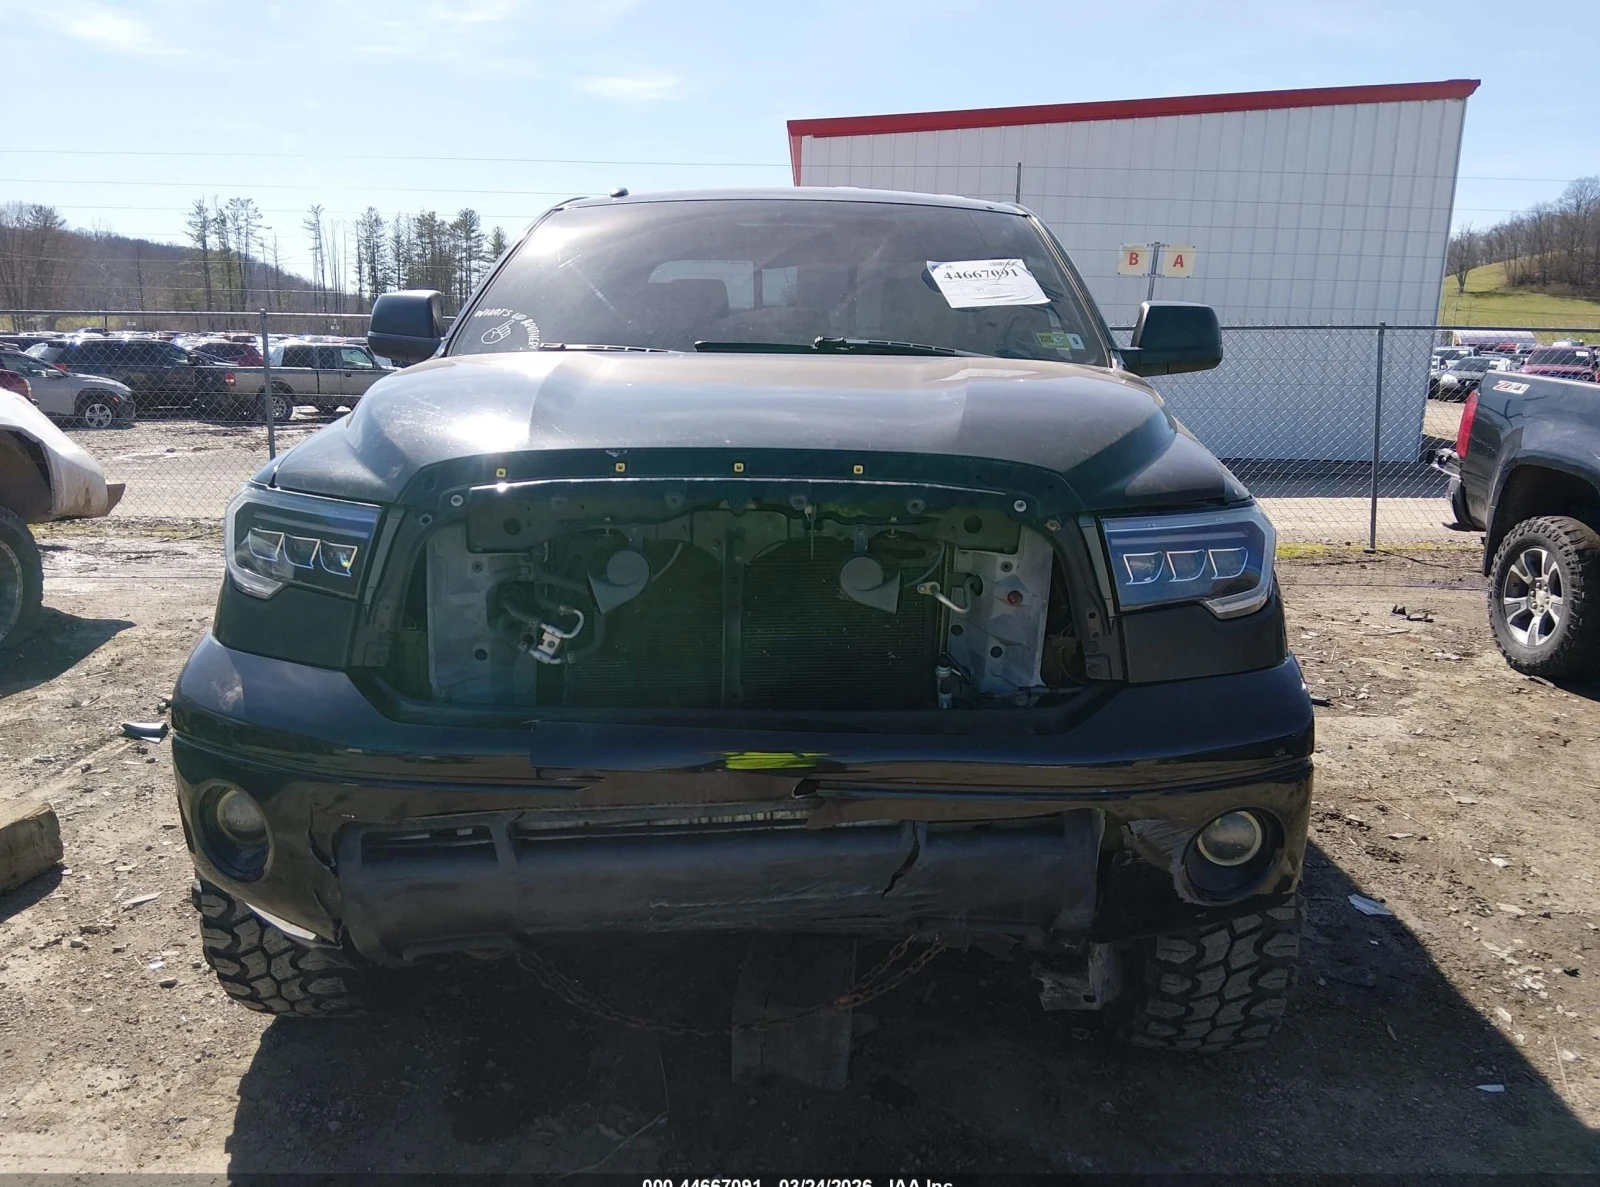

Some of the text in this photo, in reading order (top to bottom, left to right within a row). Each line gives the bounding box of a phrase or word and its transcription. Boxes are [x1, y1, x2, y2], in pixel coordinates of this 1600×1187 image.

[1129, 252, 1139, 266] B
[1172, 254, 1184, 268] A
[943, 269, 1019, 281] 44667091
